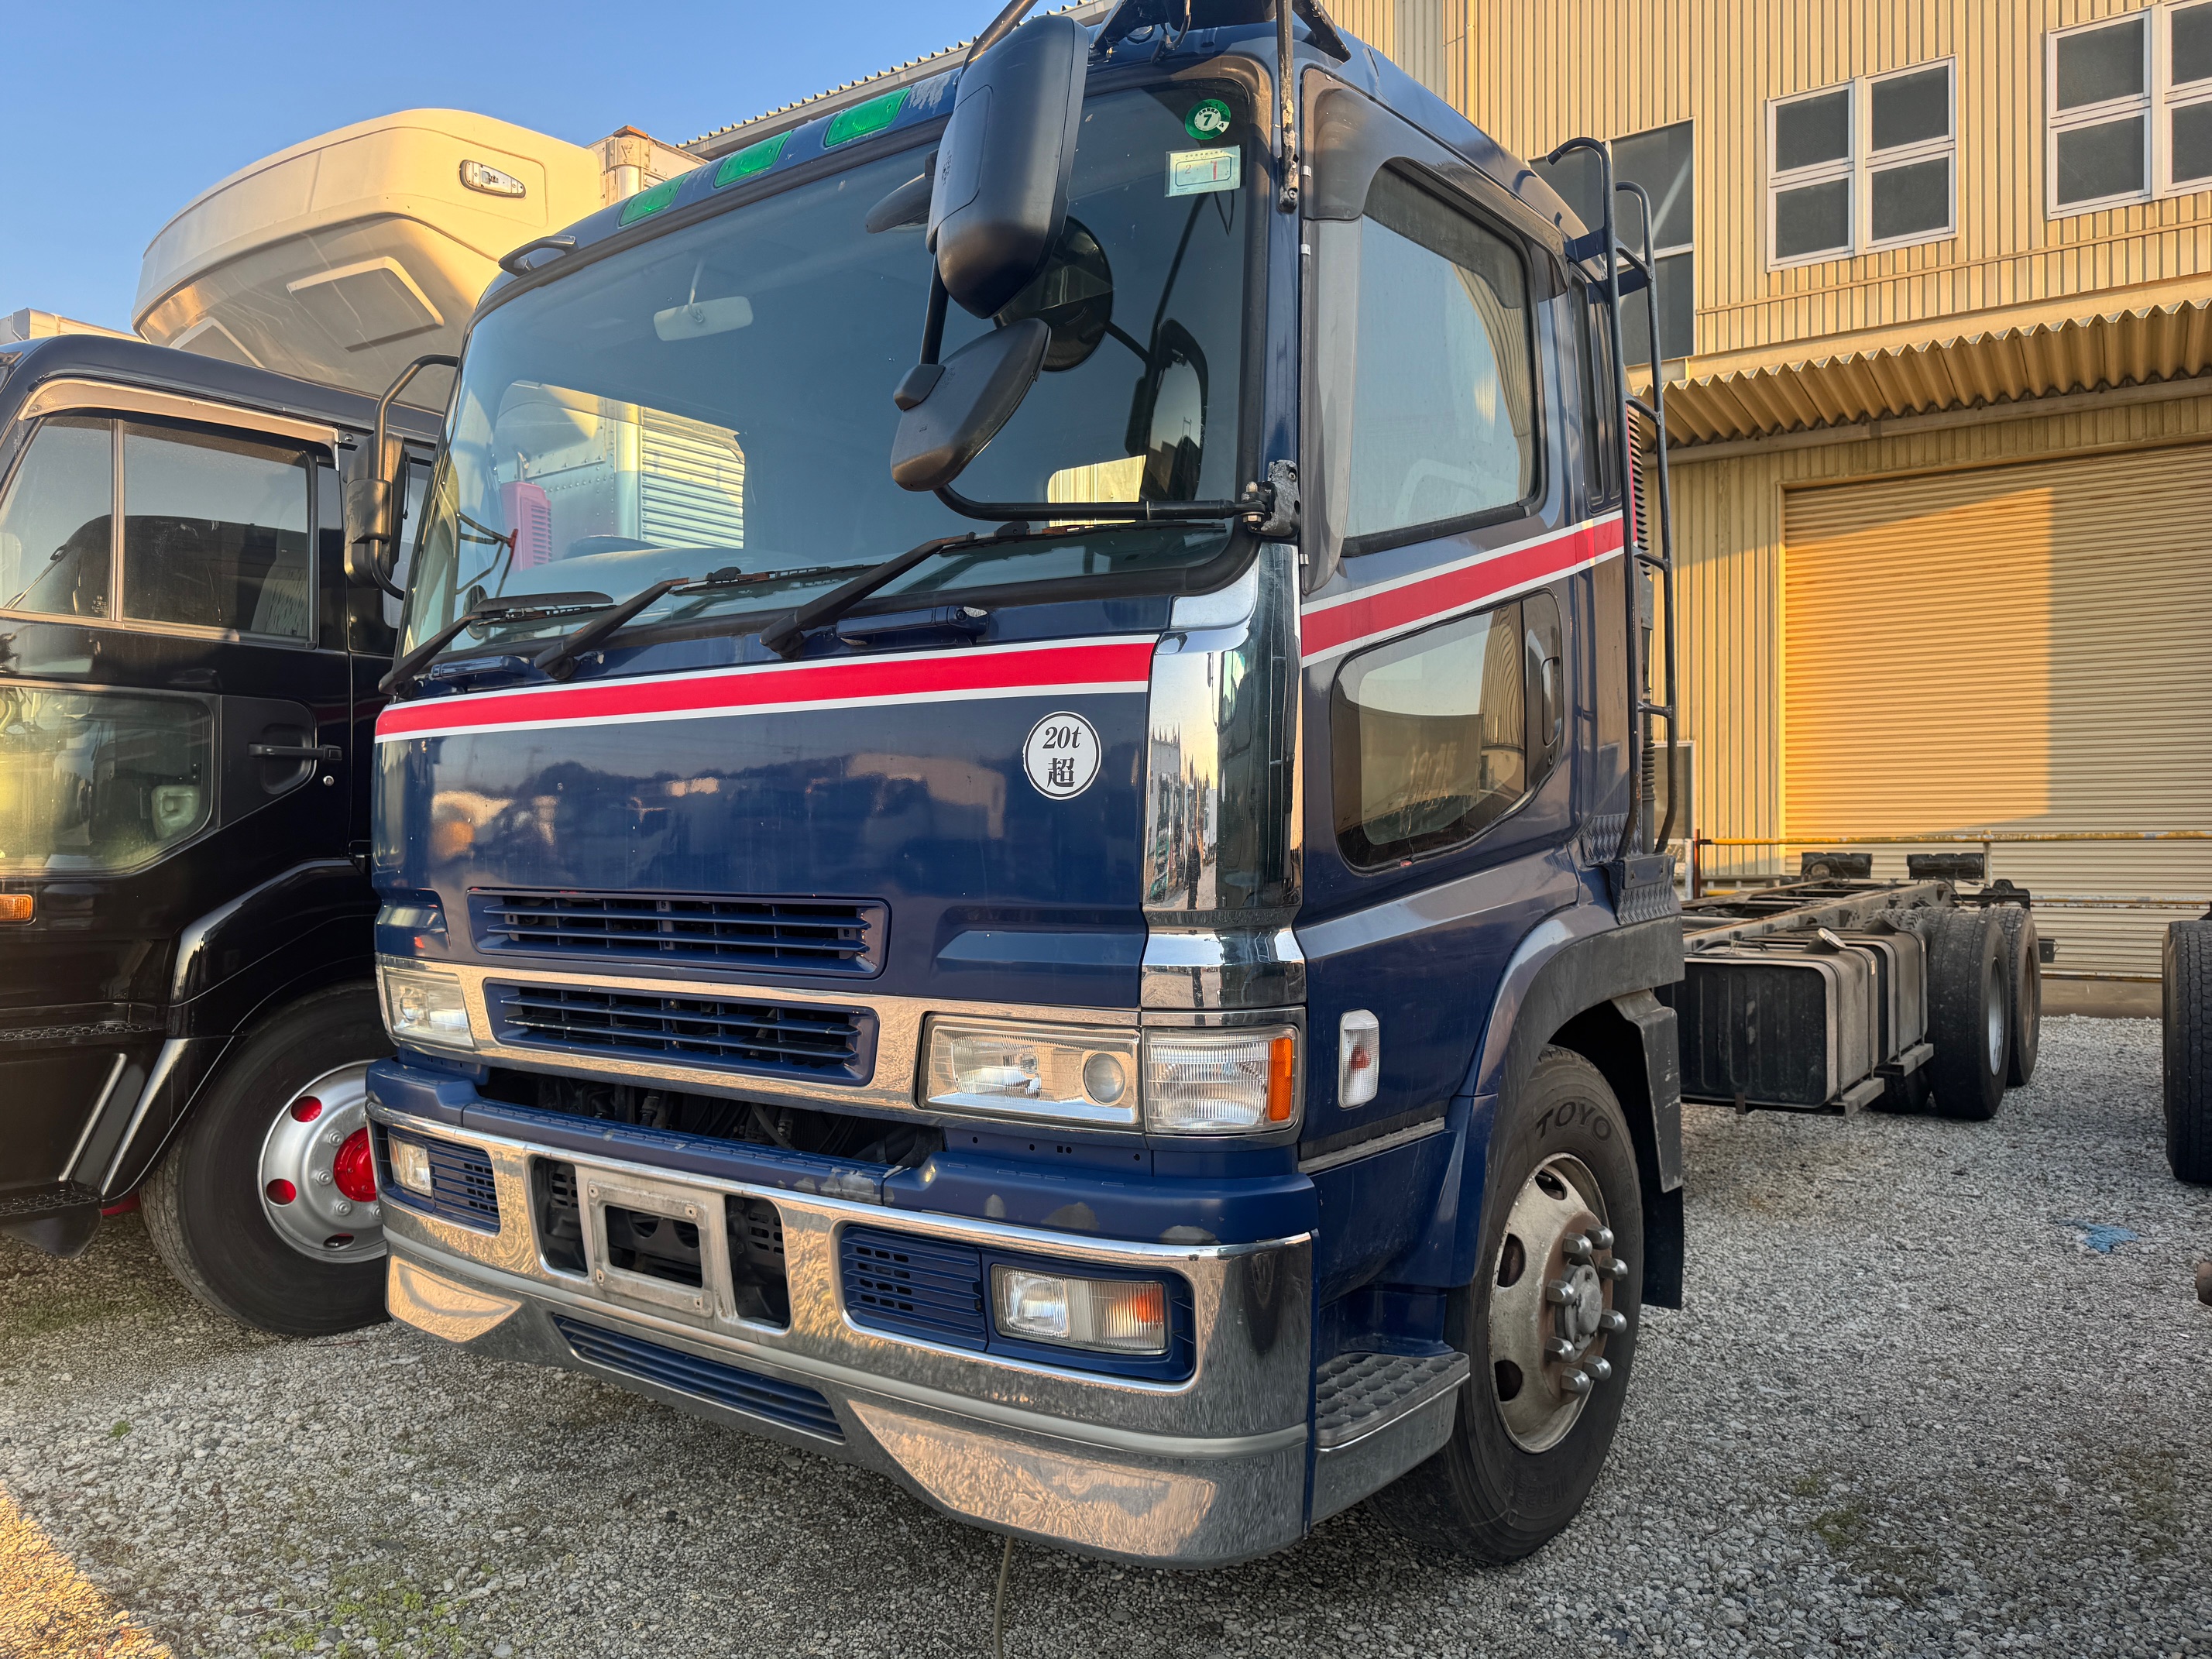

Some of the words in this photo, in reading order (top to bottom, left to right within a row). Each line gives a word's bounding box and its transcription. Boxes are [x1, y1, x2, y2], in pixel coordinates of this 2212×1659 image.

[1204, 114, 1212, 126] 7
[1185, 164, 1191, 174] 2
[1042, 726, 1081, 749] 20t
[1047, 757, 1075, 788] 超
[1535, 1101, 1612, 1142] TOYO
